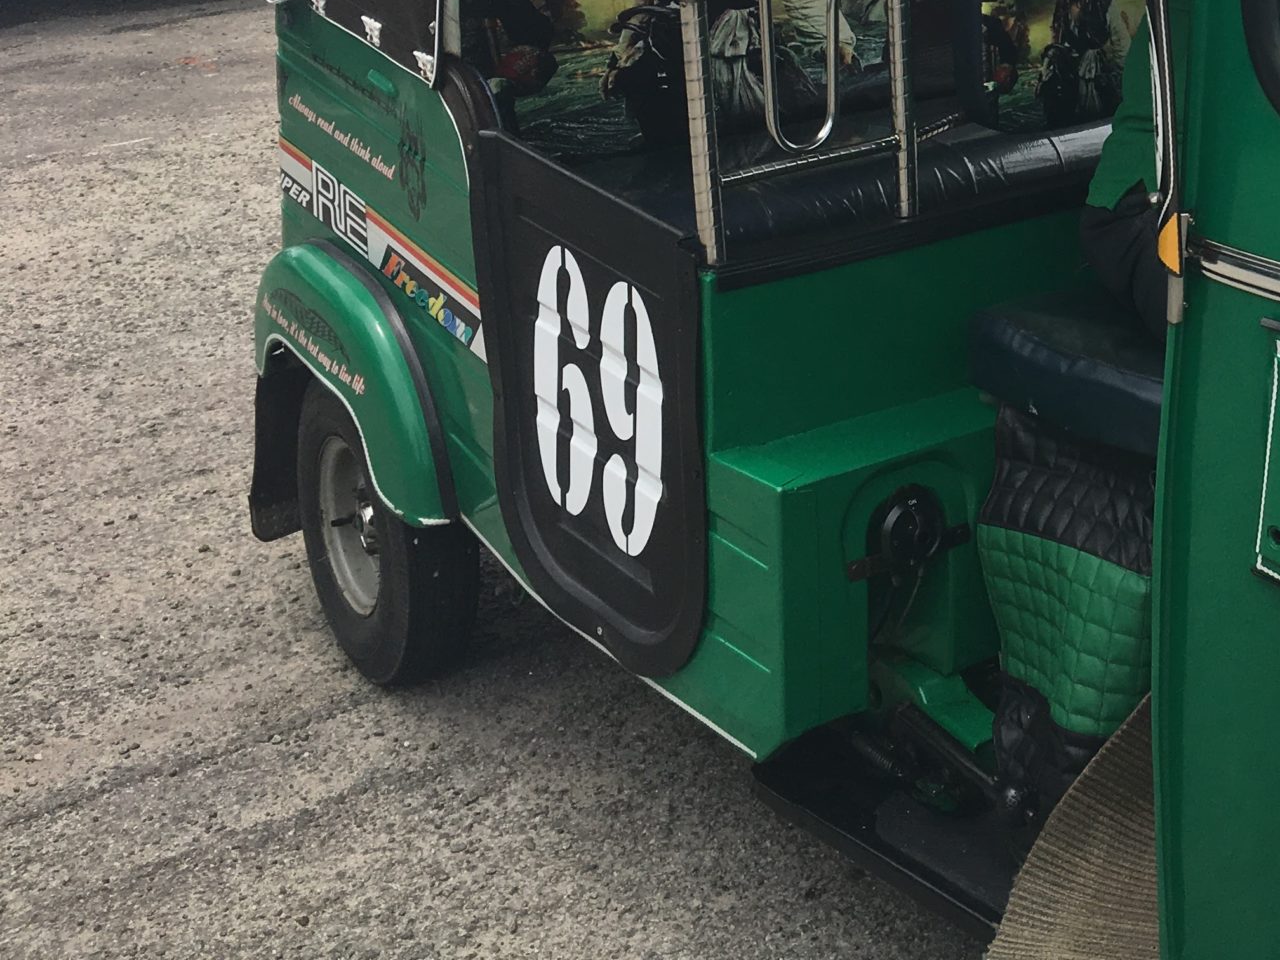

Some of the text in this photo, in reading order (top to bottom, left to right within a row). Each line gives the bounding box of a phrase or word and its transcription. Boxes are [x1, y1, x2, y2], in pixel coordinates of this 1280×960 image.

[288, 94, 396, 181] Always read and think aloud
[383, 251, 473, 345] Freedom
[534, 245, 664, 557] 69
